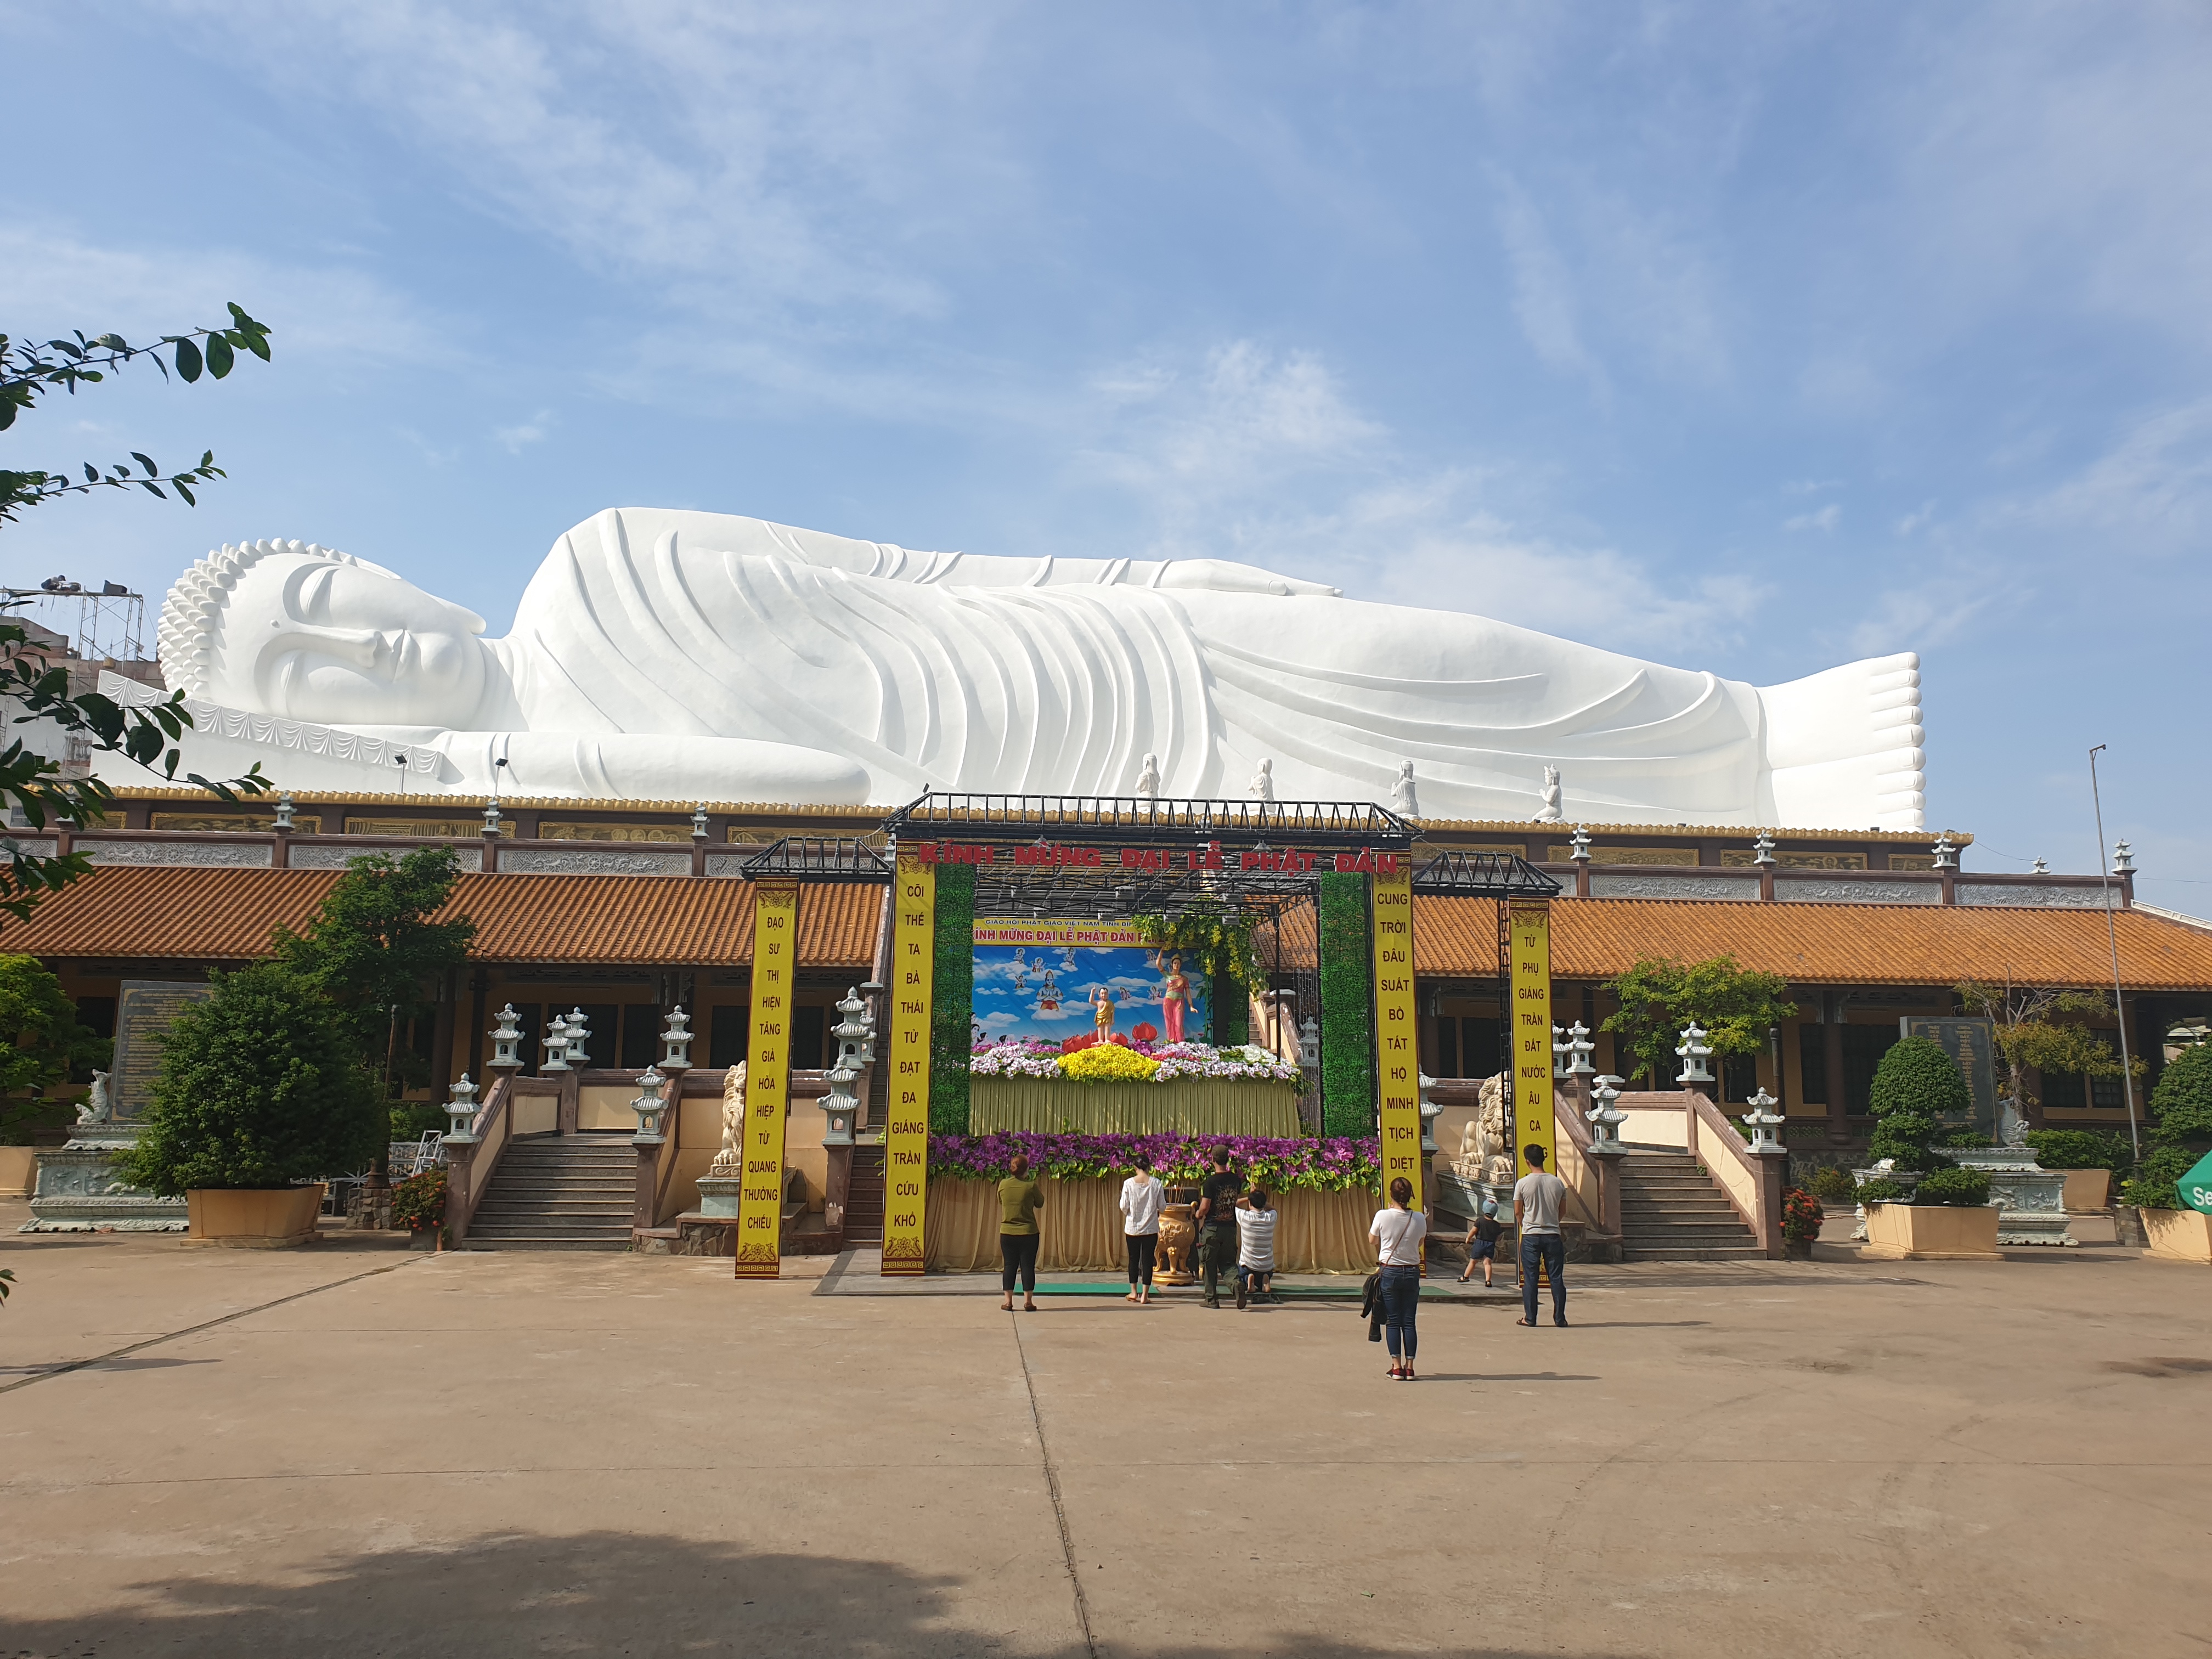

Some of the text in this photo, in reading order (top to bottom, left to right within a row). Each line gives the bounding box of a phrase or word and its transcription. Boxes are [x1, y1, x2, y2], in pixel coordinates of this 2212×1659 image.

[919, 839, 1397, 877] KÍNH MỪNG ĐẠI LỄ PHẬT ĐẢN
[907, 883, 924, 898] CÕI
[1377, 893, 1408, 905] CUNG
[767, 917, 784, 931] ĐẠO
[1380, 919, 1406, 934] TRỜI
[999, 927, 1034, 941] MỪNG
[1036, 930, 1057, 945] ĐẠI
[1059, 926, 1074, 941] LỄ
[1077, 929, 1108, 945] PHẬT
[1110, 928, 1136, 943] ĐẢN
[1524, 934, 1536, 948] TỪ
[769, 943, 781, 955] SƯ
[908, 943, 921, 955] TA
[1383, 947, 1405, 962] ĐÂU
[766, 969, 779, 984] THỊ
[906, 969, 920, 984] BÀ
[1522, 962, 1539, 977] PHỤ
[1519, 985, 1544, 1000] GIÁNG
[762, 995, 781, 1011] HIỆN
[900, 999, 923, 1014] THÁI
[904, 1028, 919, 1043] TỬ
[1386, 1035, 1408, 1050] TÁT
[761, 1047, 775, 1062] GIÀ
[900, 1061, 921, 1076] ĐẠT
[1391, 1066, 1407, 1082] HỘ
[1521, 1064, 1545, 1079] NƯỚC
[758, 1075, 775, 1090] HÒA
[902, 1091, 916, 1104] ĐA
[1386, 1097, 1414, 1109] MINH
[1528, 1090, 1540, 1105] ÂU
[756, 1104, 775, 1120] HIỆP
[892, 1119, 924, 1134] GIÁNG
[1530, 1120, 1541, 1131] CA
[758, 1130, 770, 1145] TỪ
[1388, 1127, 1414, 1142] TỊCH
[748, 1160, 776, 1173] QUANG
[1390, 1156, 1414, 1173] DIỆT
[744, 1186, 778, 1201] THƯỜNG
[896, 1180, 918, 1196] CỨU
[2193, 1186, 2212, 1206] Se
